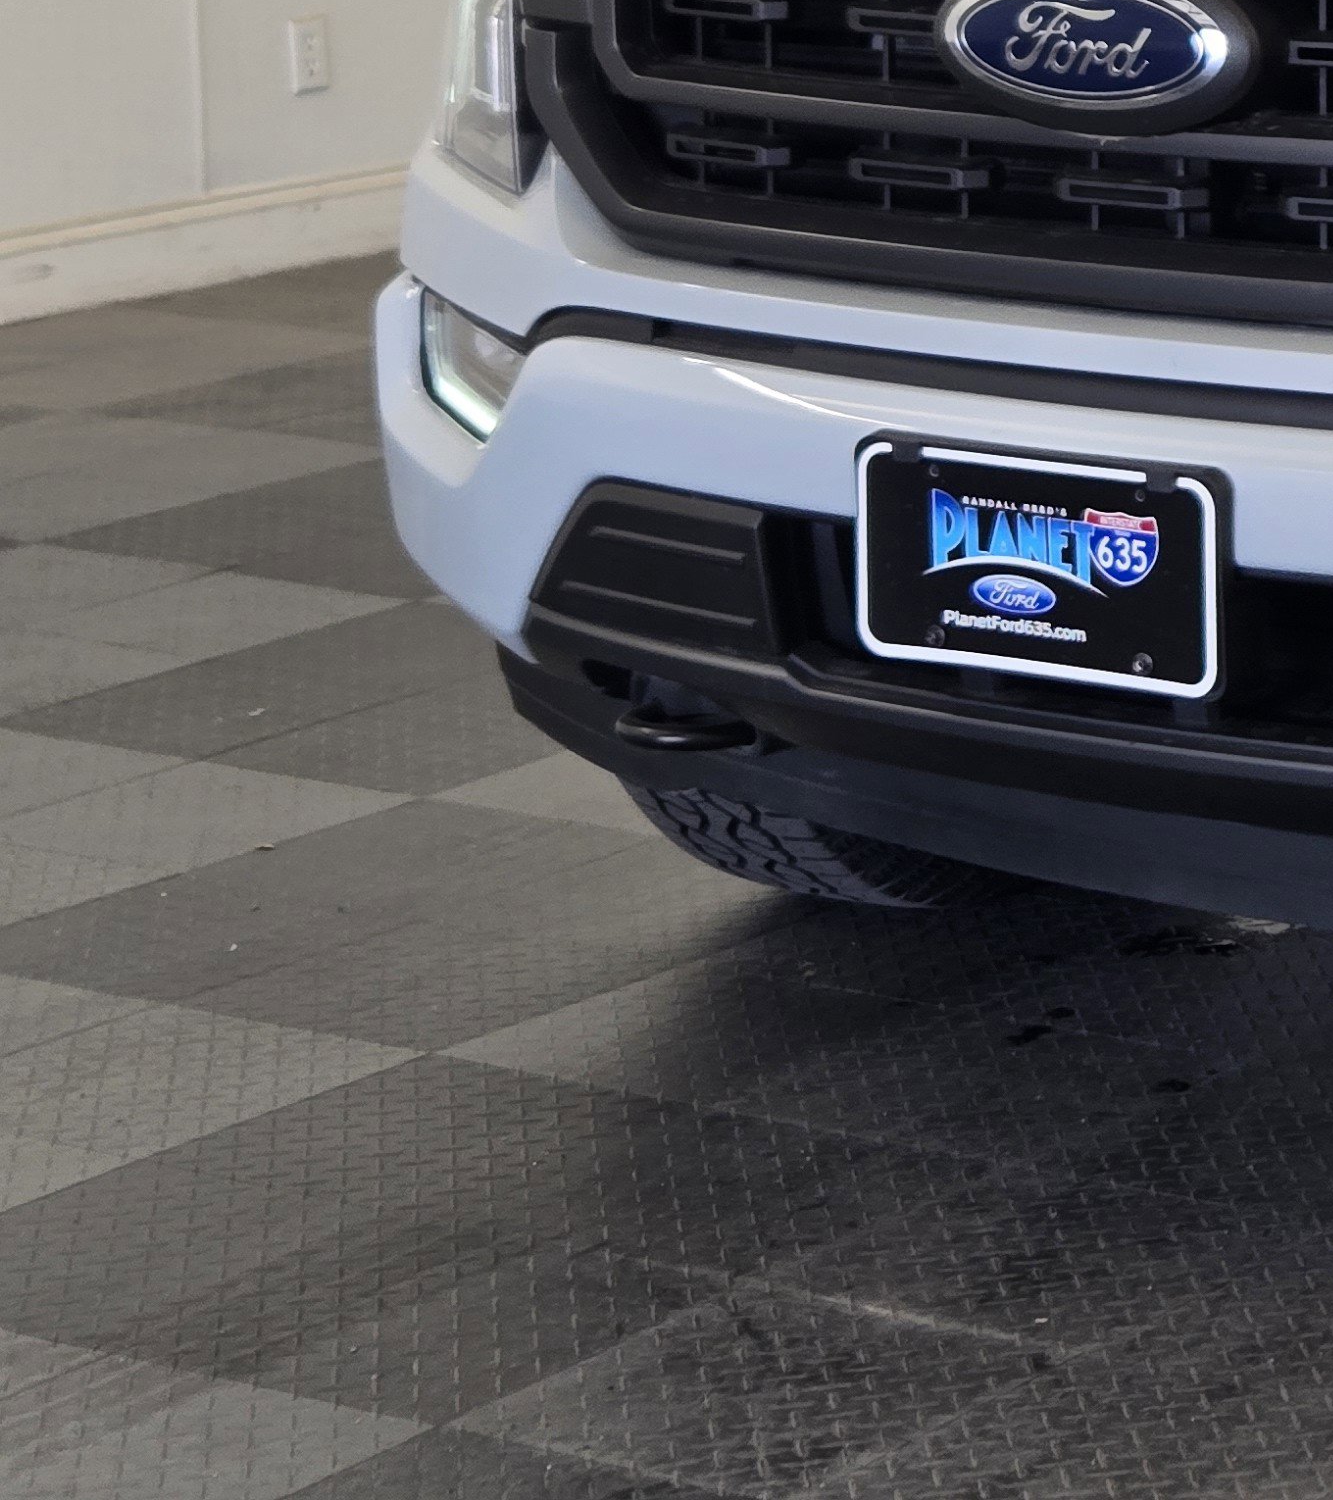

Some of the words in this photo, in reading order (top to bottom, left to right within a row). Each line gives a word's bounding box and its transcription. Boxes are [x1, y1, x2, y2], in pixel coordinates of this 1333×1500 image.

[1005, 1, 1152, 80] Ford
[931, 488, 1095, 586] PLANET
[1097, 535, 1148, 574] 635
[989, 579, 1040, 610] Ford
[942, 608, 1088, 643] PlanetFord635.com
